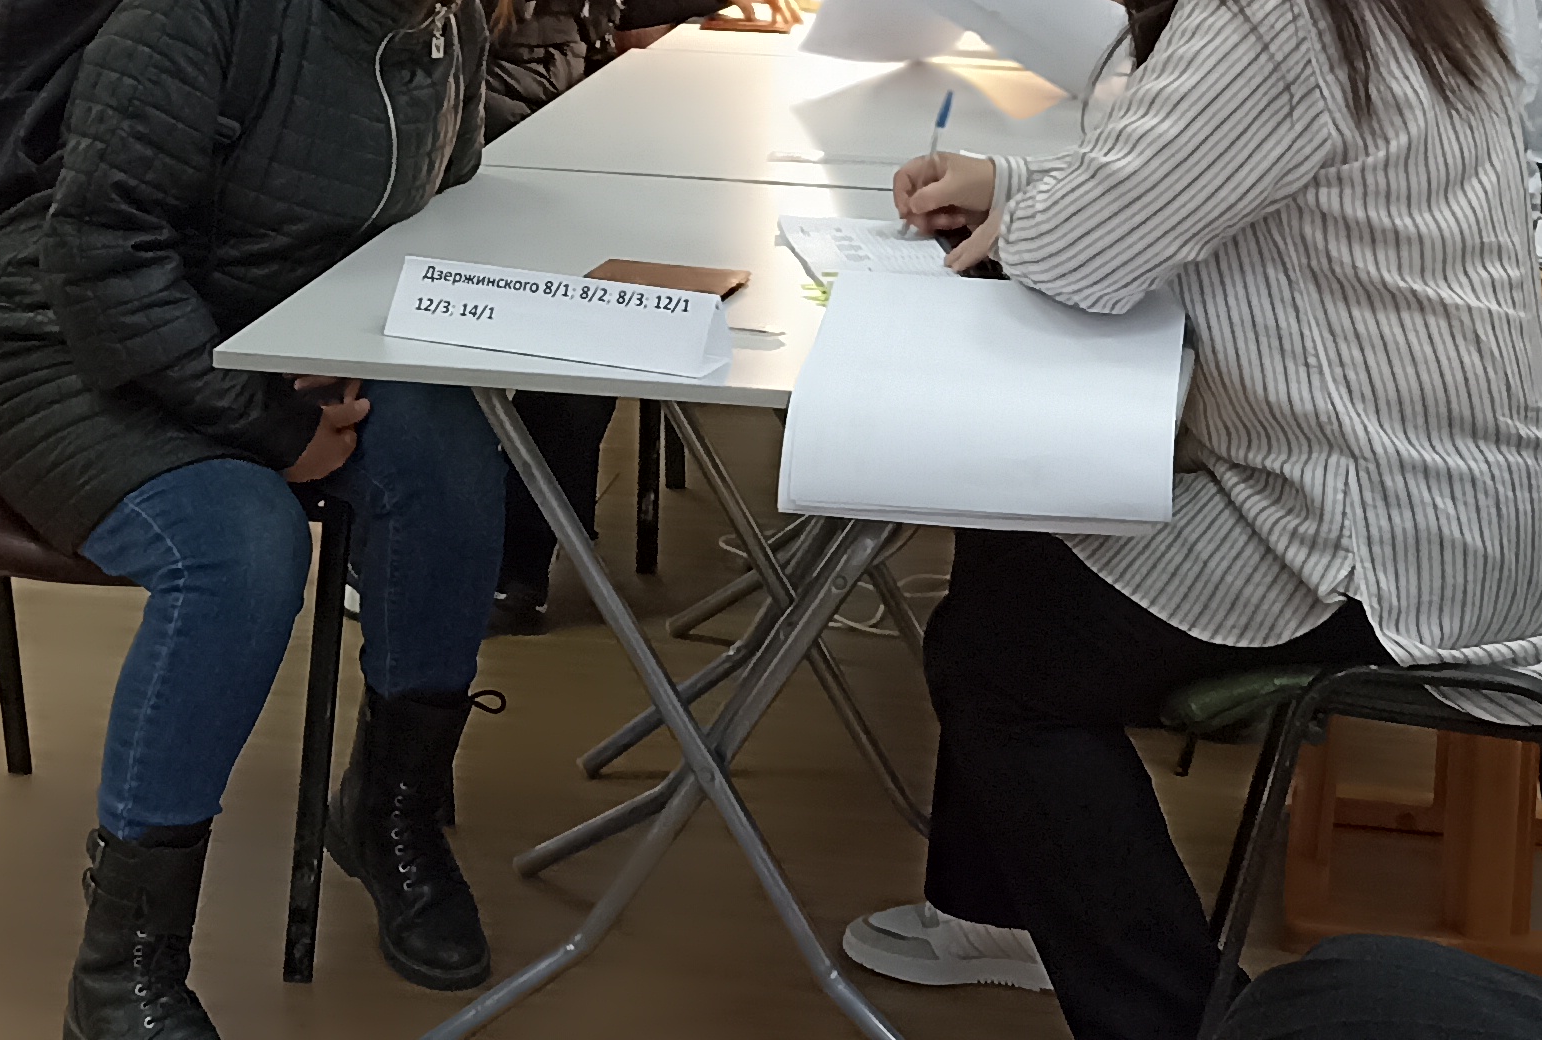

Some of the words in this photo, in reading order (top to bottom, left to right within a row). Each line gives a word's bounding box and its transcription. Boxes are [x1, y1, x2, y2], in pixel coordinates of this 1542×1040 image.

[422, 265, 540, 294] Дзержинского
[542, 281, 577, 298] 8/1;
[579, 285, 612, 304] 8/2;
[616, 290, 649, 309] 8/3;
[654, 295, 690, 313] 12/1
[415, 297, 456, 315] 12/3;
[459, 303, 495, 320] 14/1
